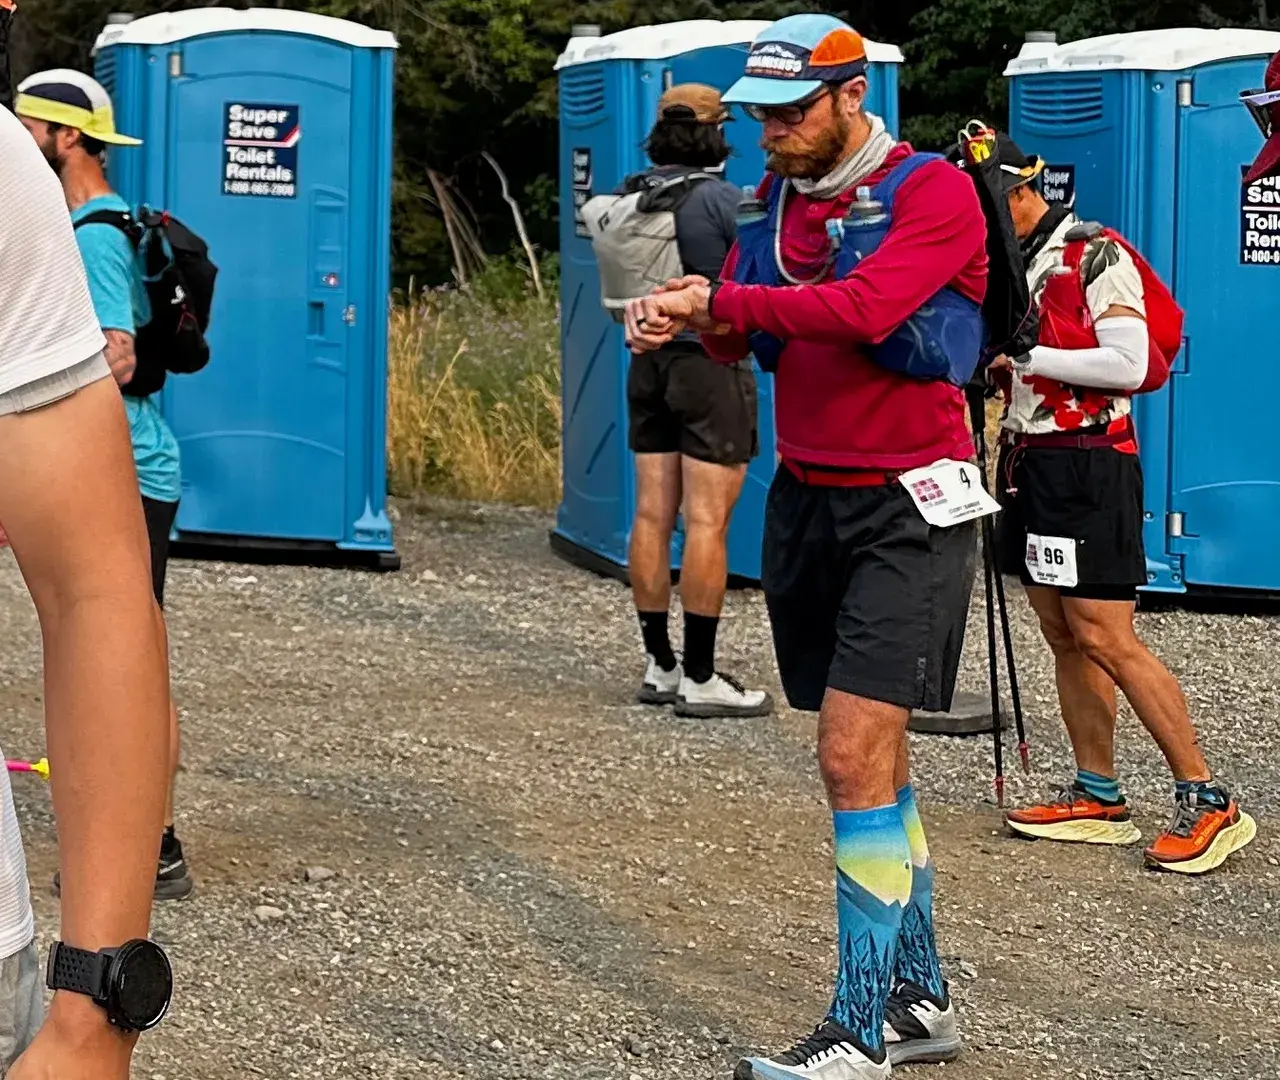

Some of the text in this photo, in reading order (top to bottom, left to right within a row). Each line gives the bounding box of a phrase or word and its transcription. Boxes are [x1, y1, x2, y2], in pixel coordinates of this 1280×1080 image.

[229, 104, 289, 125] Super
[228, 121, 277, 139] Save
[226, 146, 276, 164] Toilet
[226, 162, 293, 182] Rentals
[1044, 168, 1070, 187] Super
[1044, 185, 1065, 200] Save
[1245, 212, 1280, 230] Toil
[1044, 546, 1064, 565] 96
